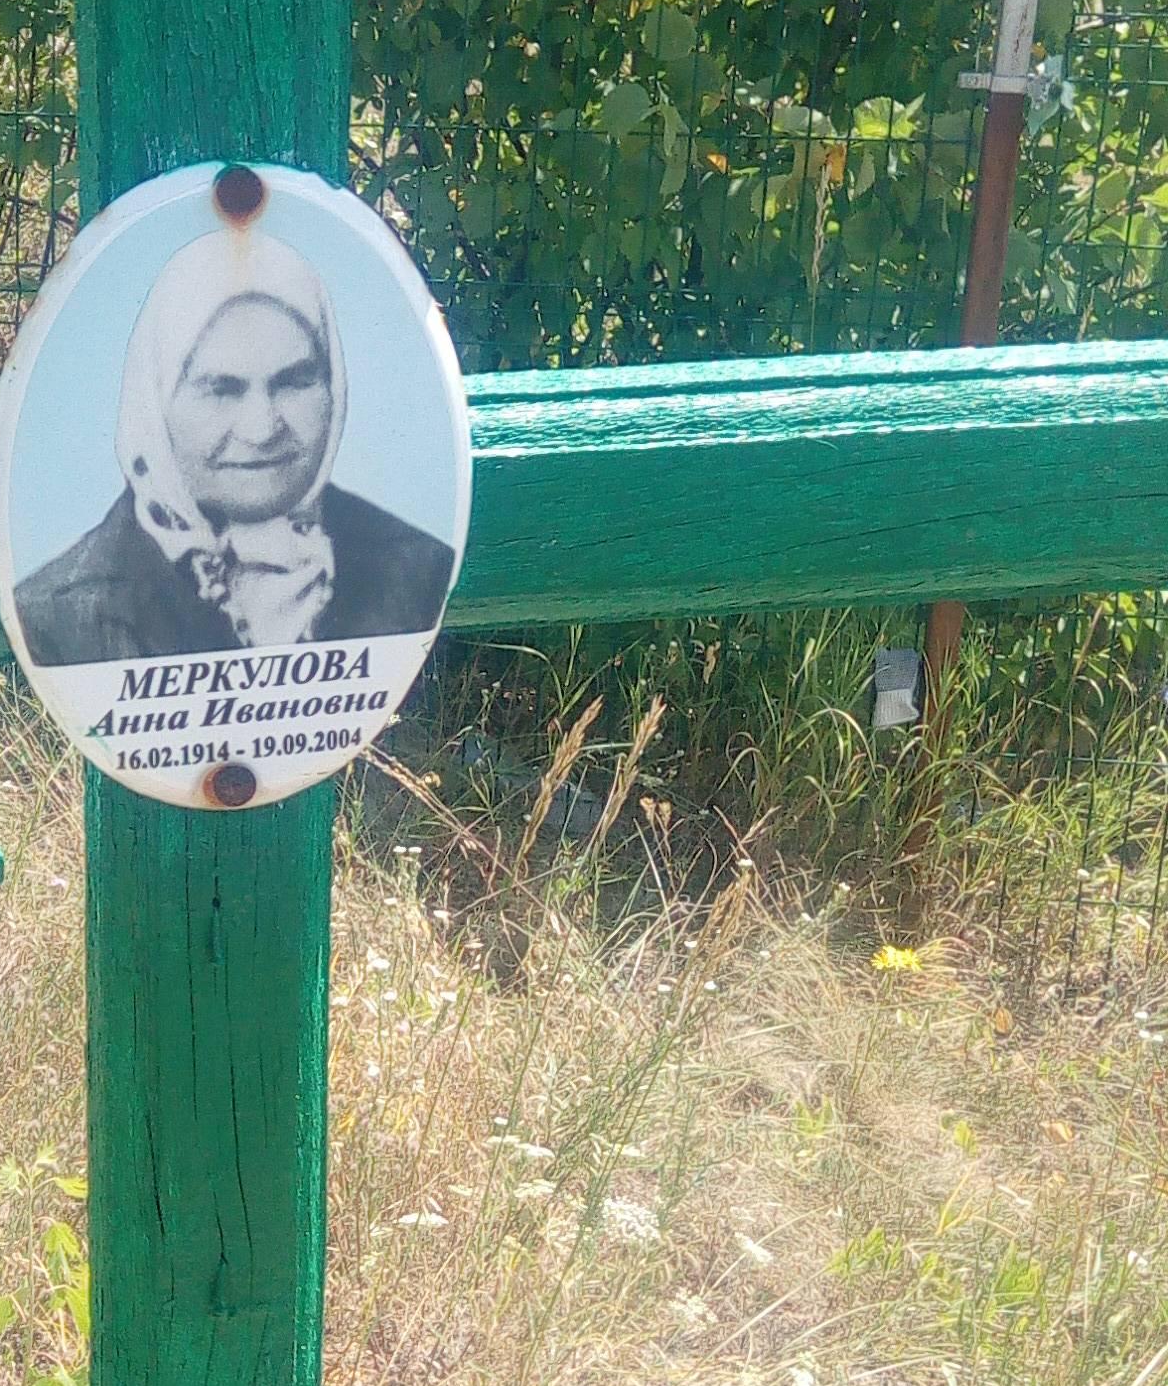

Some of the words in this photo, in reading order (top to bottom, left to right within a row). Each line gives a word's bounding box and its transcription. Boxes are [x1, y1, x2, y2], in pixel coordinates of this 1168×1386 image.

[116, 647, 372, 702] МЕРКУЛОВА
[85, 708, 190, 738] Анна
[199, 690, 390, 728] Ивановна
[116, 739, 230, 771] 16.02.1914
[252, 727, 363, 759] 19.09.2004
